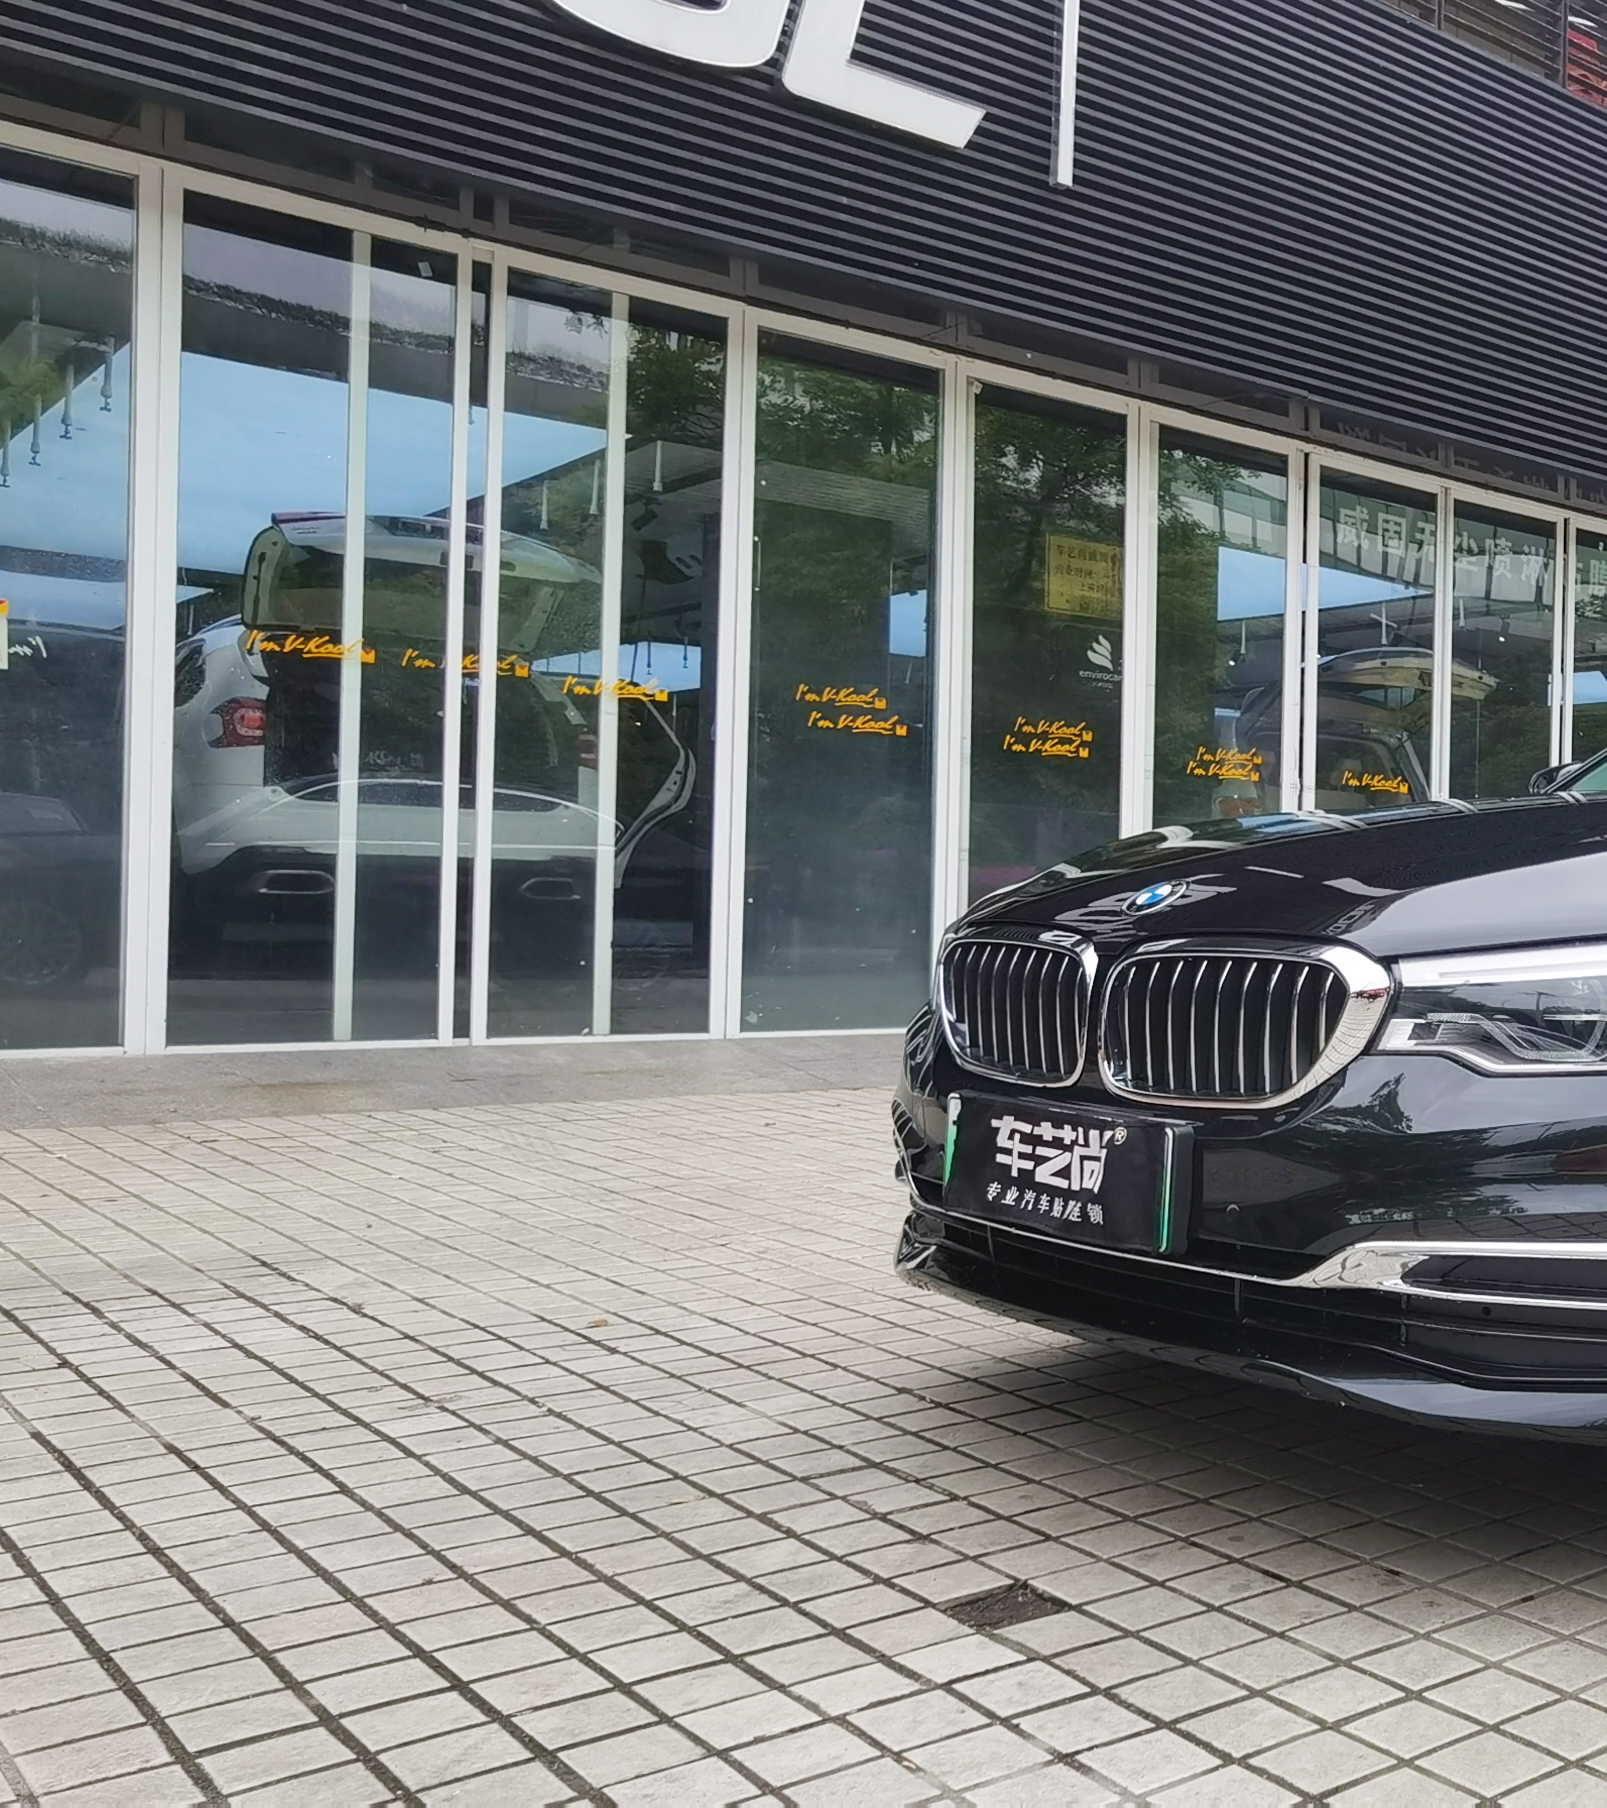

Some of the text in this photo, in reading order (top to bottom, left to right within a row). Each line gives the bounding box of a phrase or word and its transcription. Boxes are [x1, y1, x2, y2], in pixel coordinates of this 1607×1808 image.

[795, 684, 878, 708] I'm V-Kool
[807, 711, 898, 734] I'm V-Kool
[1014, 716, 1086, 740] I'm V-Kool
[1003, 735, 1078, 757] I'm V-Kool
[1342, 771, 1402, 792] I'm V-Kool
